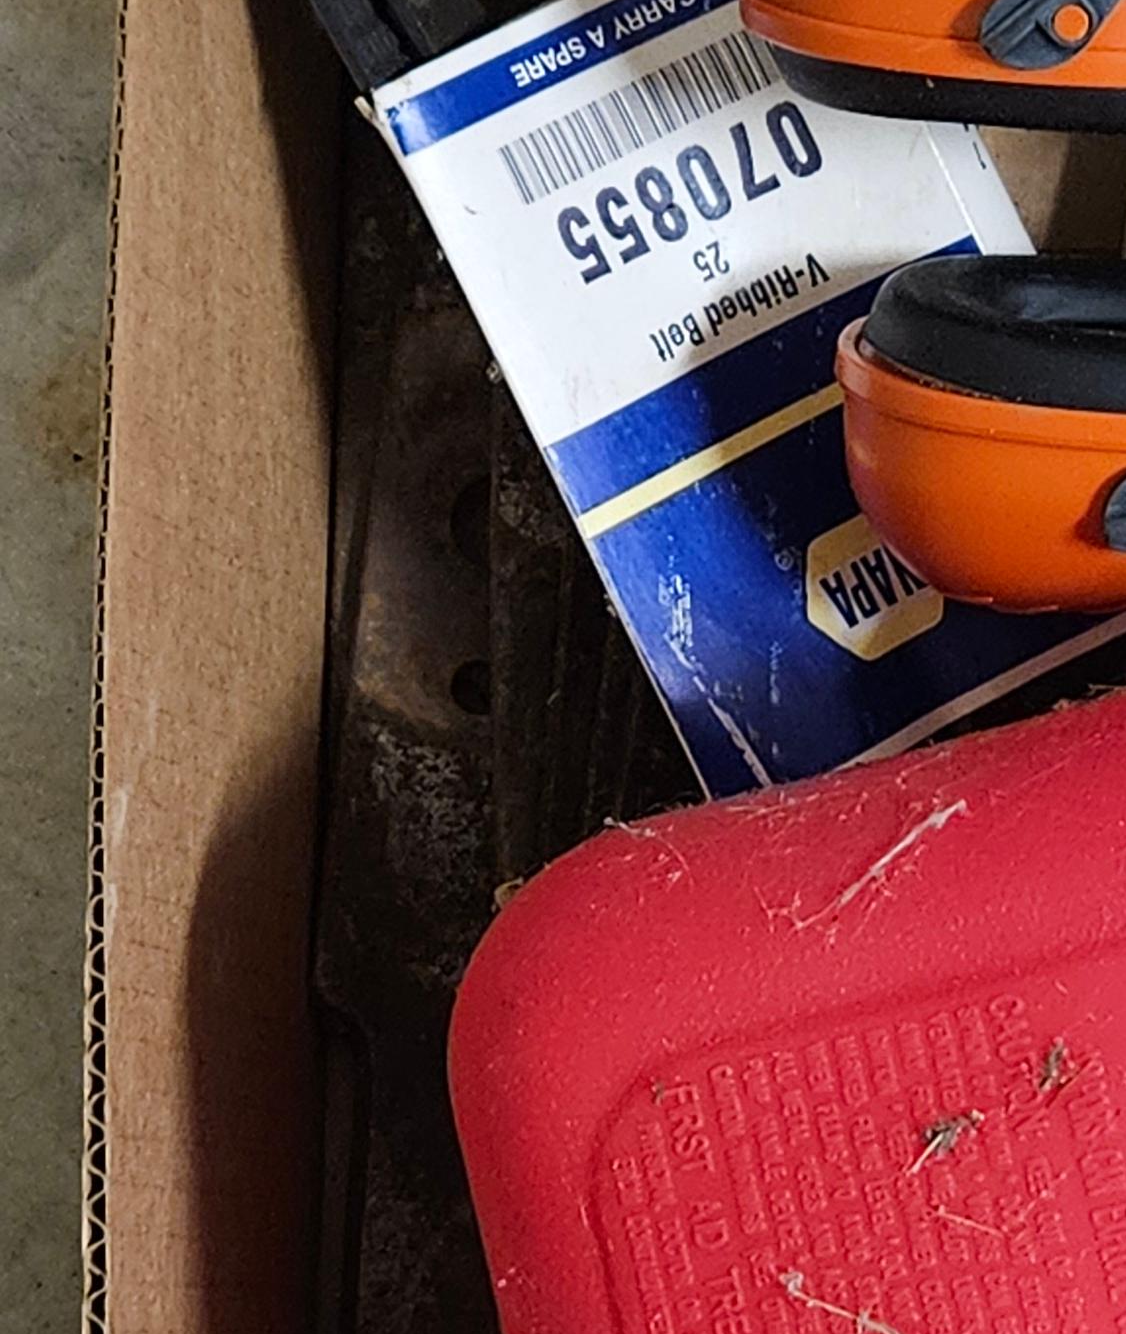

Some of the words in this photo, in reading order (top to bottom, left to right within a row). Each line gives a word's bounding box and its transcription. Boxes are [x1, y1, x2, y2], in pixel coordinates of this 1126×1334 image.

[509, 36, 586, 87] SPARE
[585, 25, 604, 48] A
[557, 101, 823, 283] 070855
[692, 240, 730, 282] 25
[706, 254, 831, 334] V-Ribbed
[649, 312, 711, 362] Belt
[818, 543, 929, 629] NAPA
[657, 1082, 717, 1180] FIRST
[685, 1195, 732, 1253] AID
